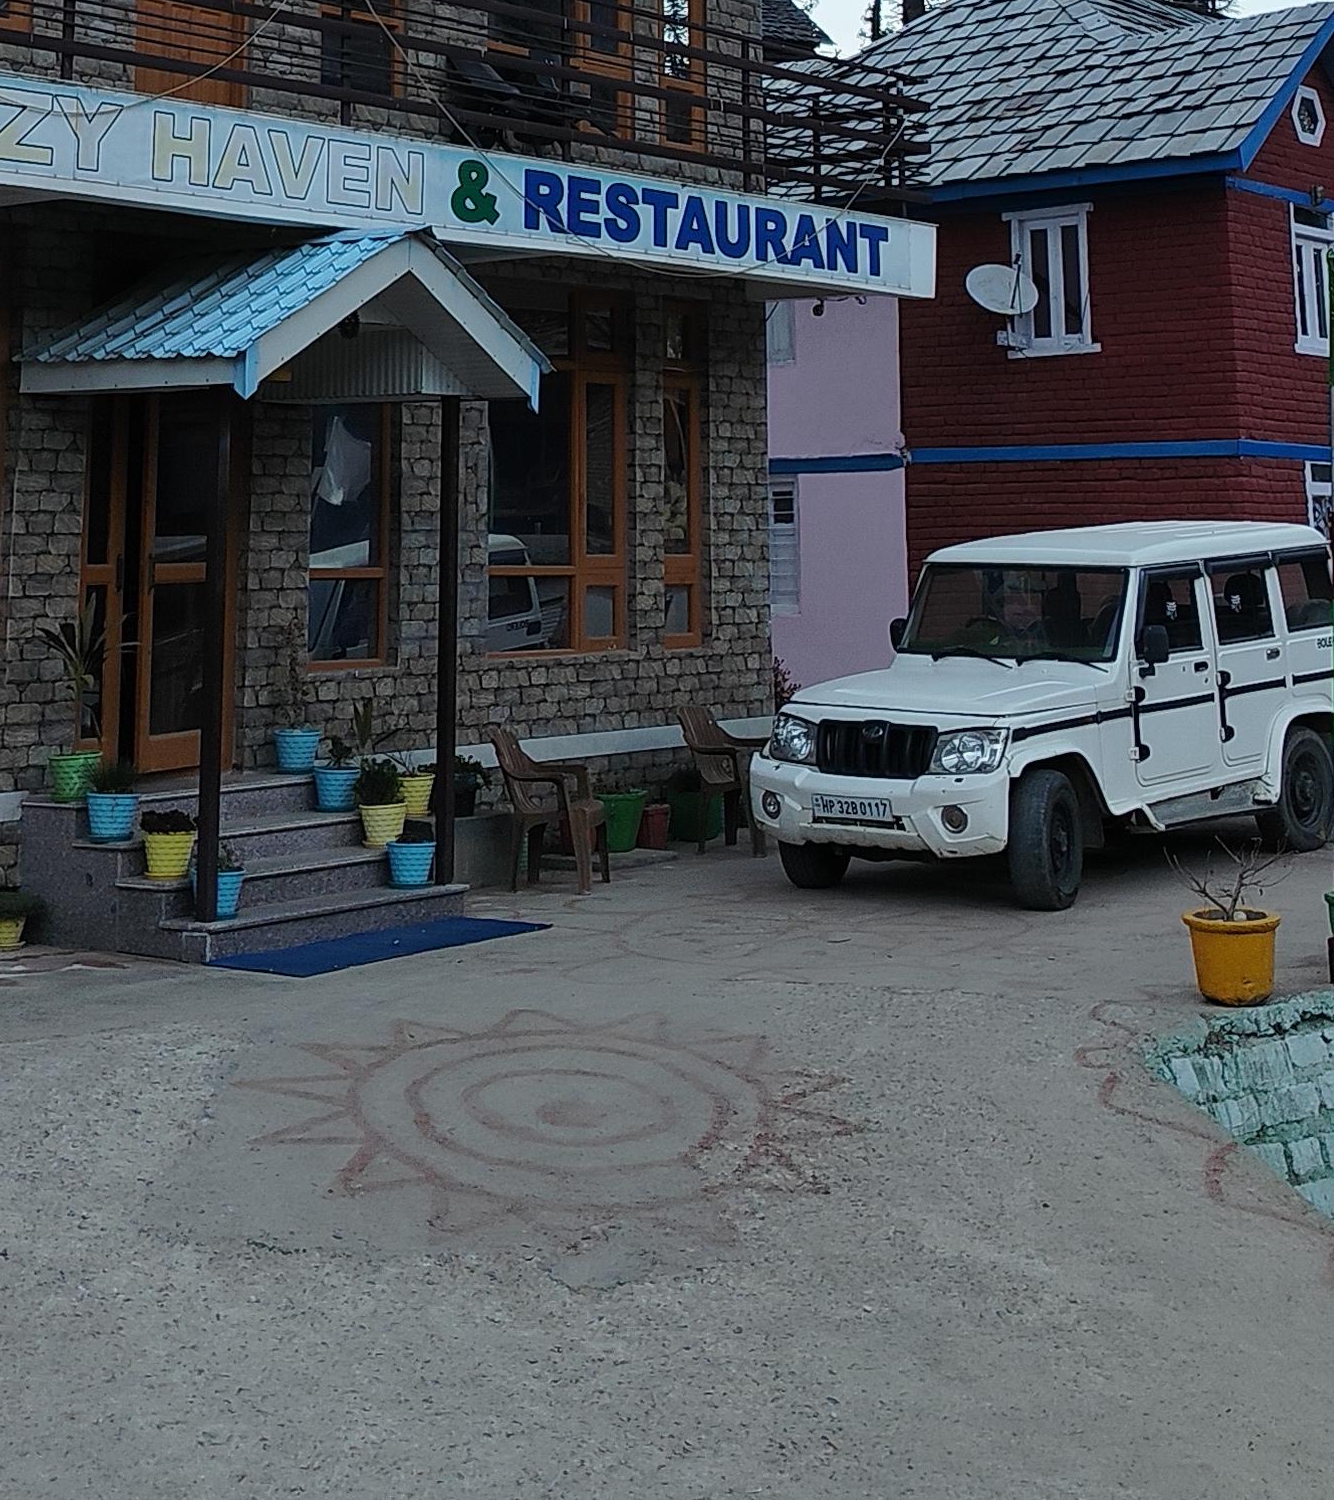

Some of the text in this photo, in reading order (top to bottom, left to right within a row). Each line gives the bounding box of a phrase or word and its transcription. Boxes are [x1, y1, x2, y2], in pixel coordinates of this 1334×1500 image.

[150, 110, 426, 217] HAVEN
[449, 158, 500, 226] &
[521, 167, 890, 280] RESTAURANT
